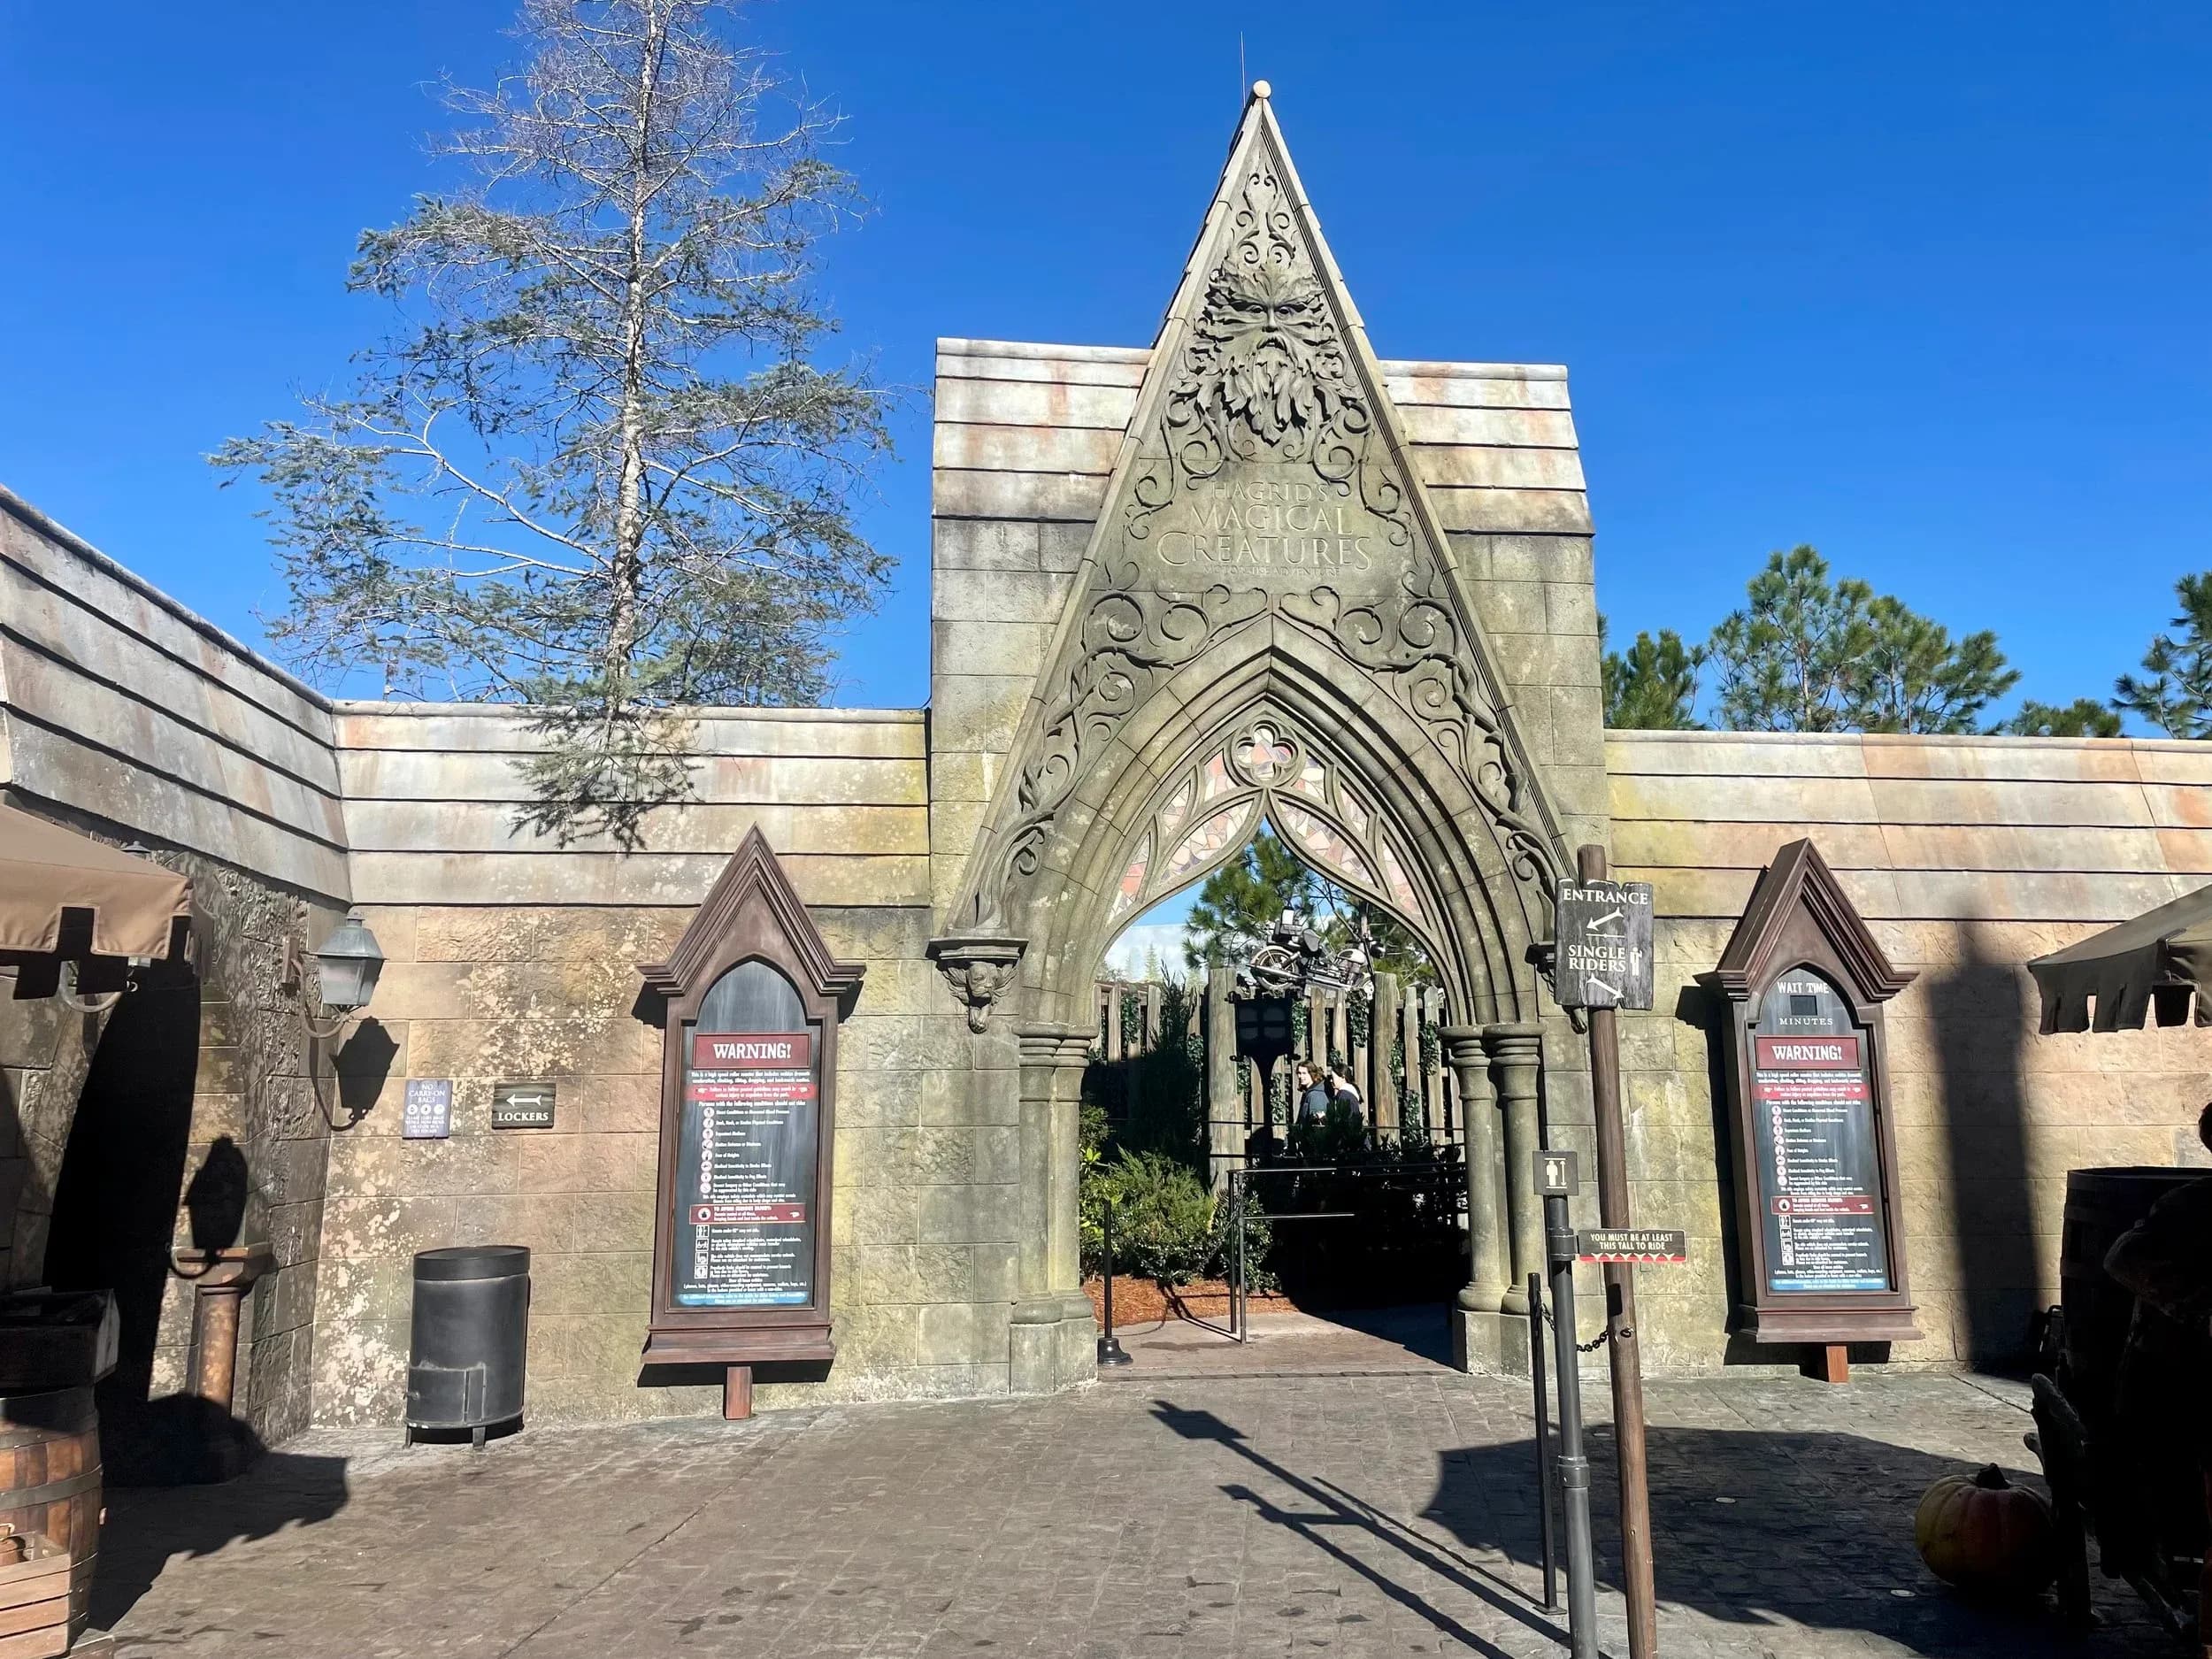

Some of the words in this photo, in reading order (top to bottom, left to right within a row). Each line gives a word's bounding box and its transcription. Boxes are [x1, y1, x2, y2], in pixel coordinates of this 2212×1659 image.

[1210, 480, 1329, 502] HAGRID'S
[1191, 503, 1354, 535] MAGICAL
[1156, 530, 1373, 571] CREATURES
[1563, 888, 1648, 905] ENTRANCE
[1568, 944, 1625, 960] SINGLE
[1568, 957, 1626, 972] RIDERS
[1777, 981, 1803, 995] WAIT
[1806, 982, 1830, 995] TIME
[713, 1042, 792, 1059] WARNING!
[1771, 1045, 1842, 1061] WARNING!
[498, 1112, 549, 1122] LOCKERS
[1590, 1233, 1606, 1242] YOU
[1608, 1233, 1629, 1242] MUST
[1630, 1233, 1640, 1242] BE
[1641, 1233, 1650, 1242] AT
[1652, 1233, 1673, 1242] LEAST
[1599, 1241, 1617, 1250] THIS
[1617, 1241, 1635, 1250] TALL
[1636, 1241, 1646, 1250] TO
[1647, 1241, 1666, 1250] RIDE
